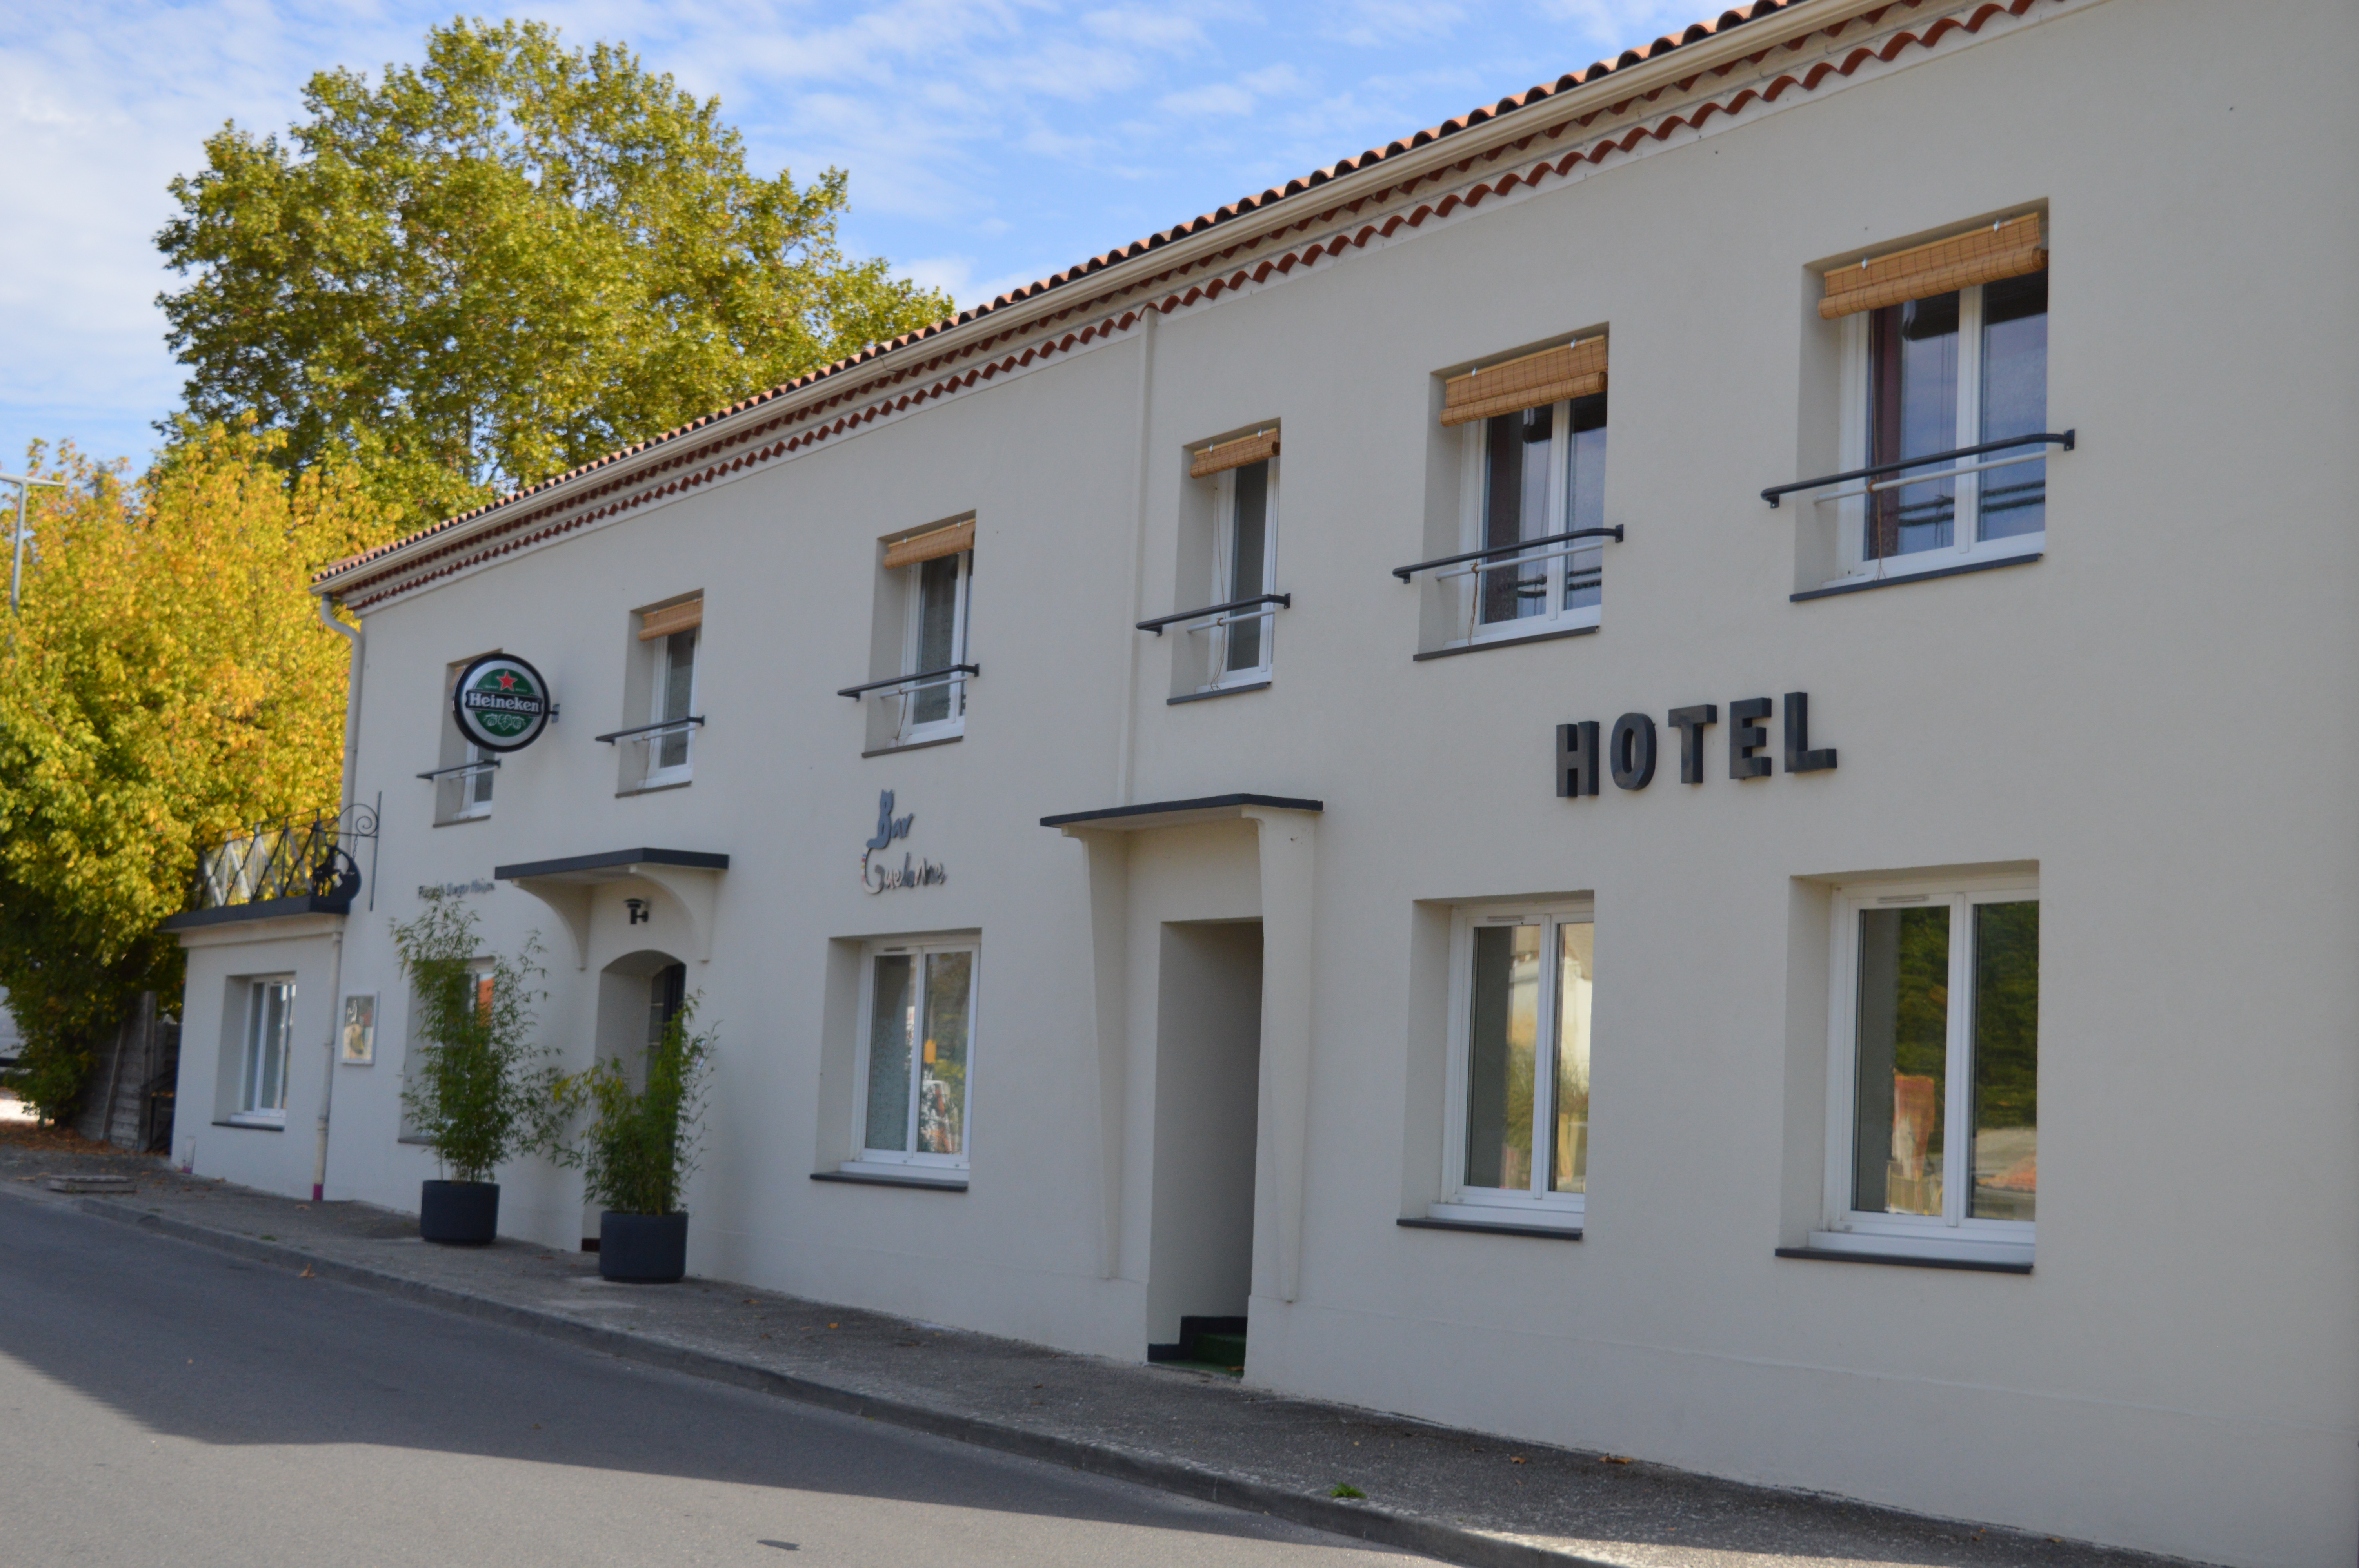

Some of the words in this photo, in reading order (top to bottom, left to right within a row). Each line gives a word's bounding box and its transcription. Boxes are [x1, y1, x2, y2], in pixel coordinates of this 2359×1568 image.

[469, 693, 540, 712] Heineken
[1556, 691, 1837, 797] HOTEL
[866, 789, 915, 849] Bar
